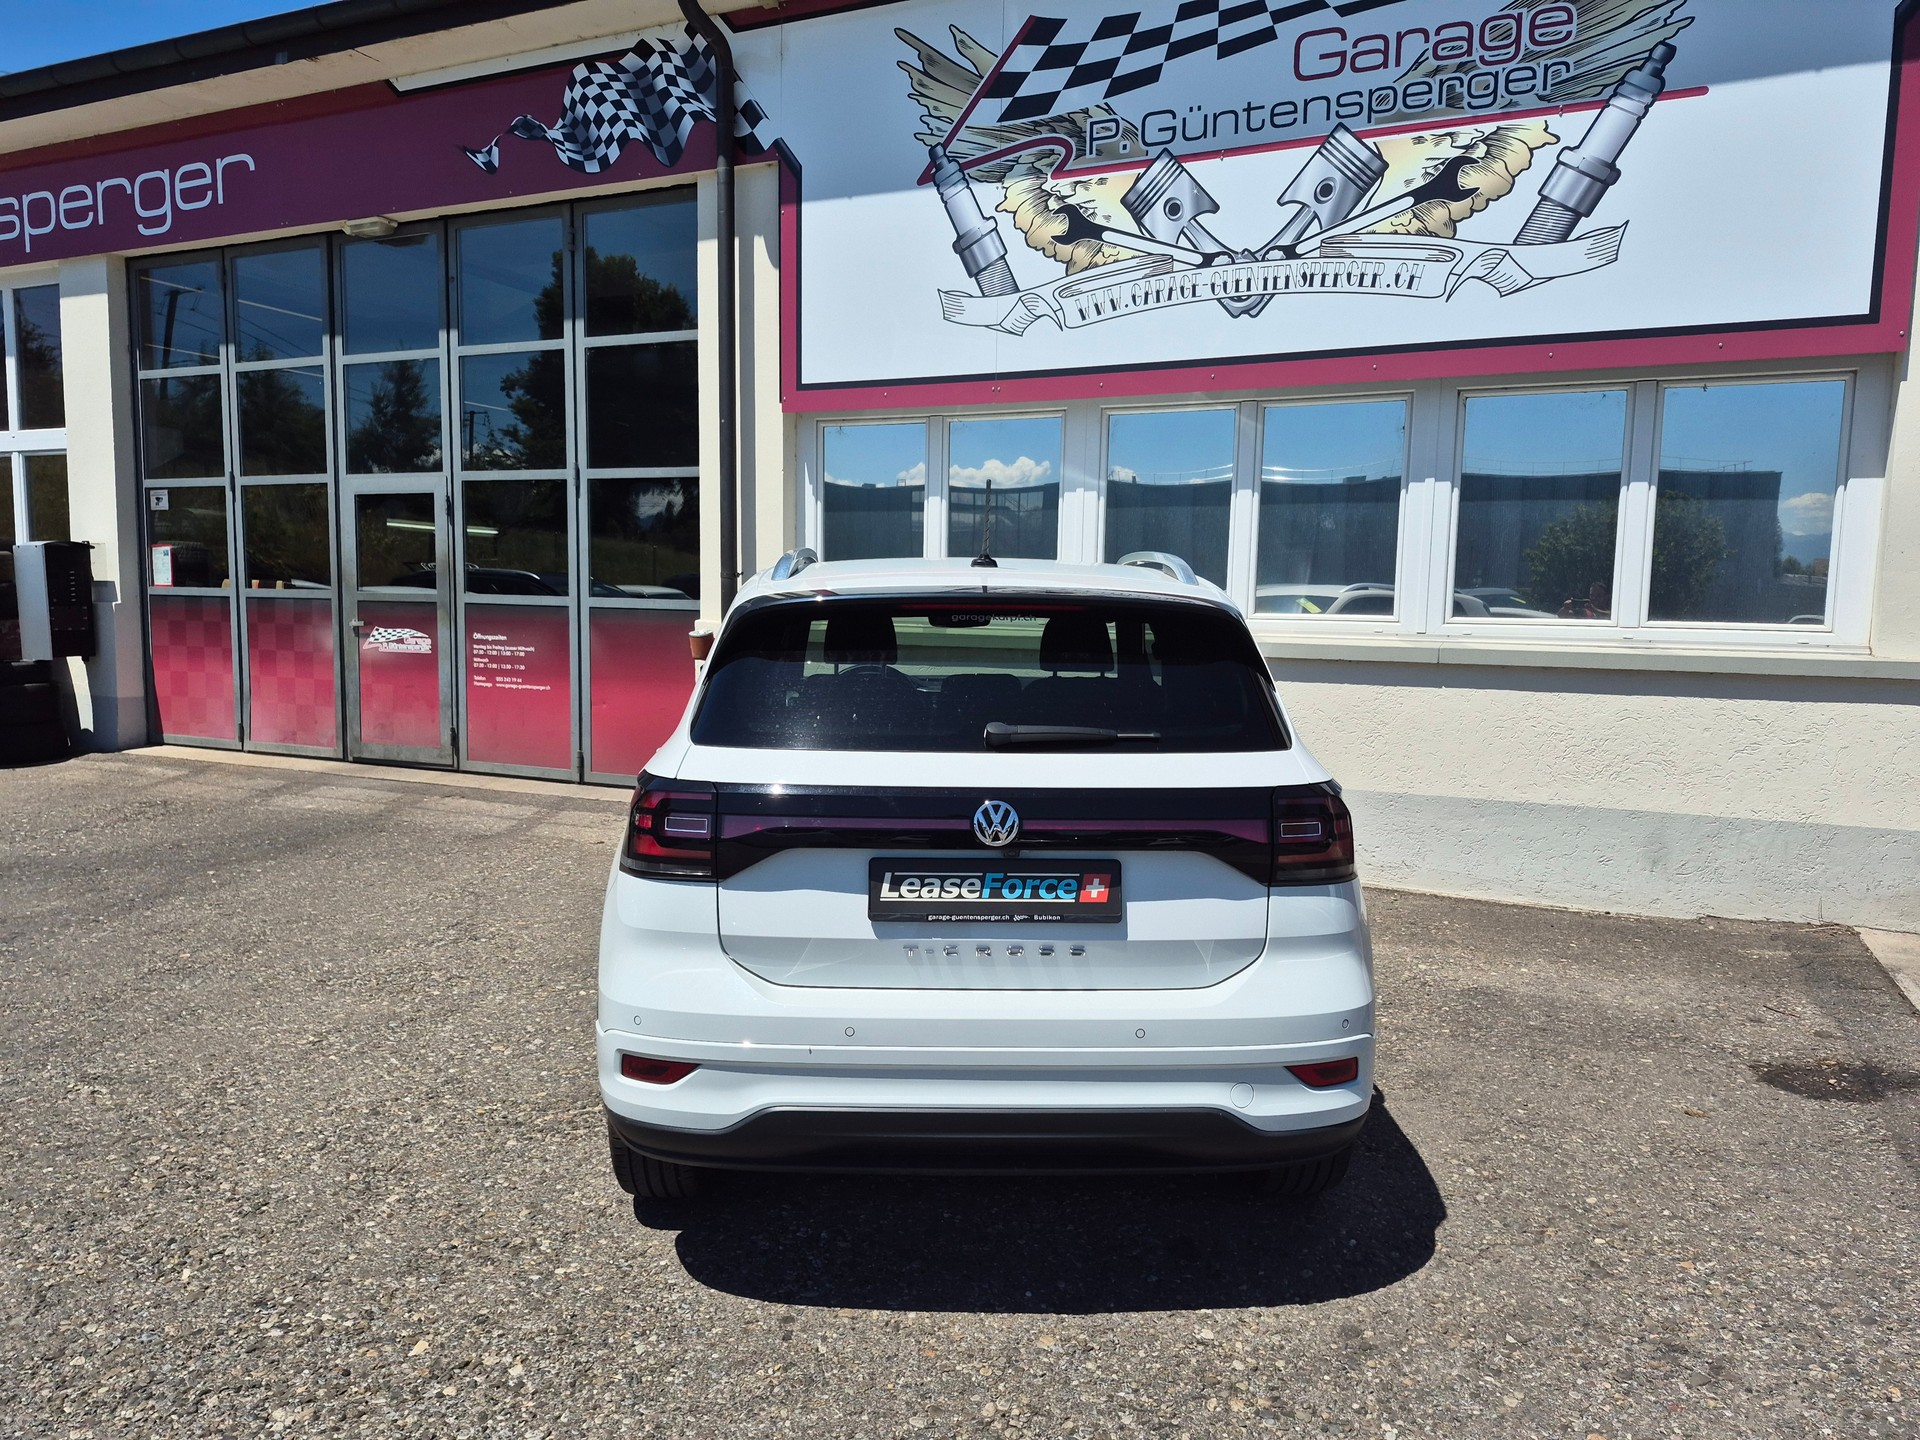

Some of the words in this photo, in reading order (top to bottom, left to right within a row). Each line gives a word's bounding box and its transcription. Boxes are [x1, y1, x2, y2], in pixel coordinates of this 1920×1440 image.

[1293, 5, 1575, 82] Garage
[1088, 117, 1127, 156] P.
[1140, 60, 1572, 145] Güntensperger
[880, 872, 1077, 899] LeaseForce
[903, 944, 1086, 957] T-CROSS
